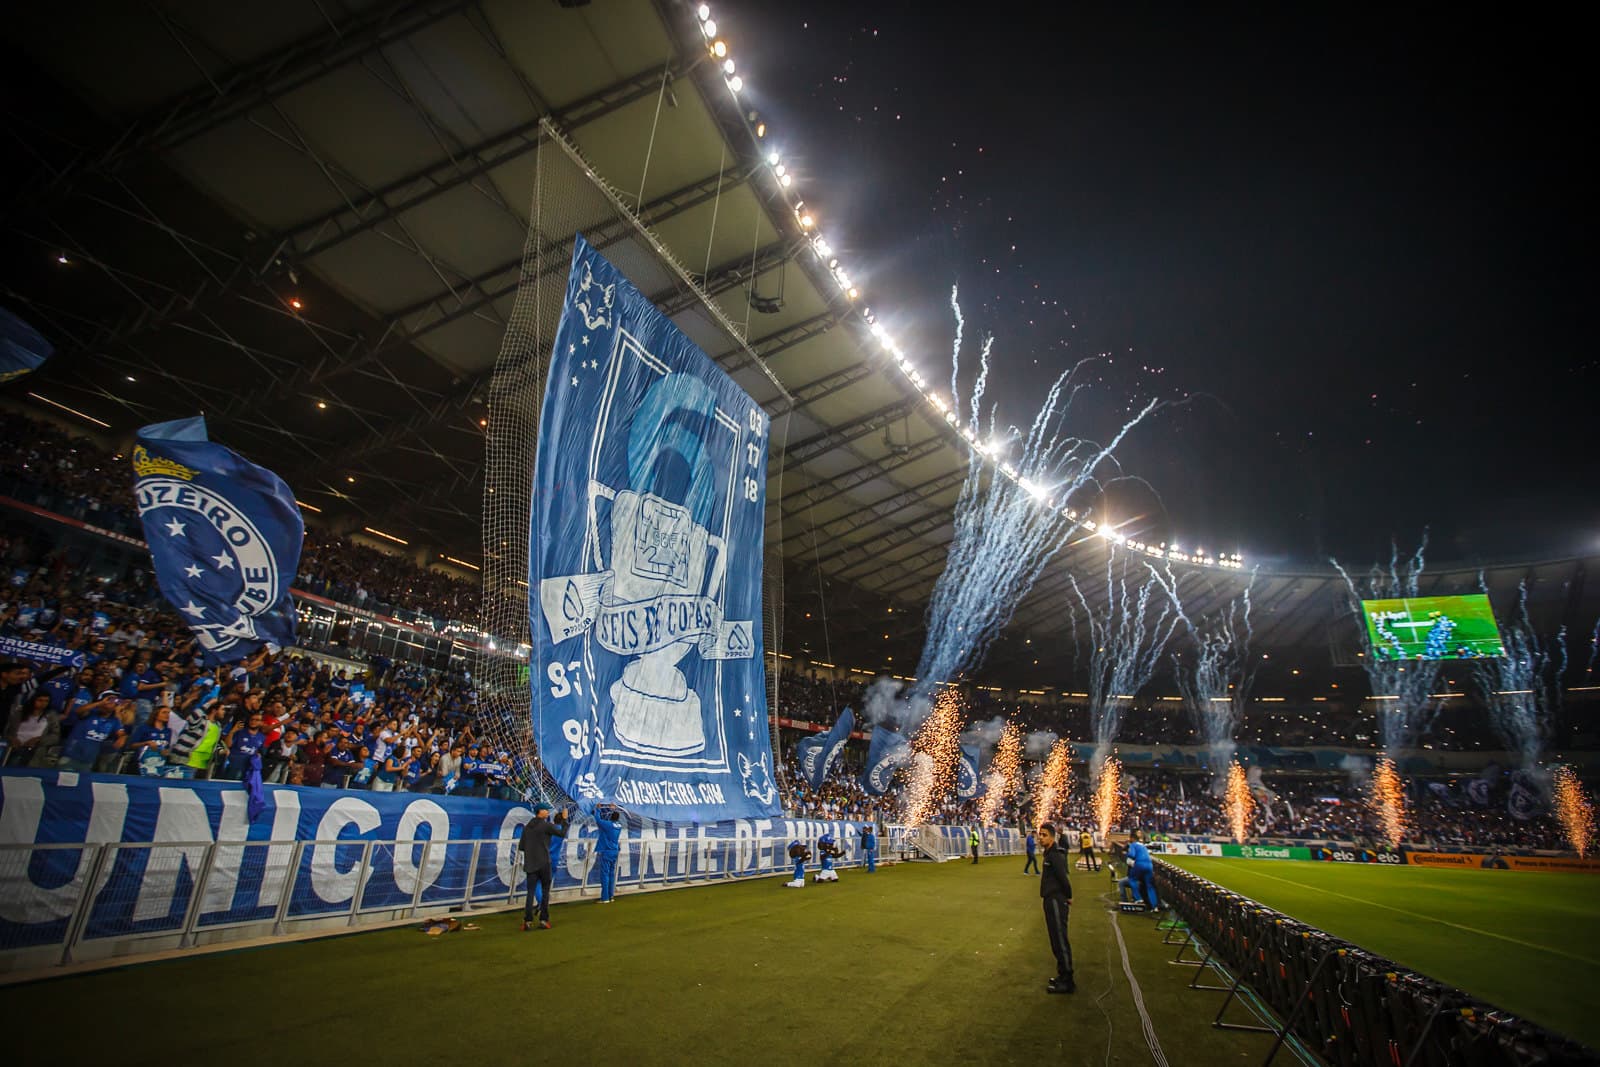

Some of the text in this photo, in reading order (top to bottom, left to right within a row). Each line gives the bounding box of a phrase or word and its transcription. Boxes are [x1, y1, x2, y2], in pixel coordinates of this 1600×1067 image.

[749, 407, 762, 437] 03
[747, 442, 760, 469] 17
[744, 476, 758, 502] 18
[601, 609, 639, 649] SEIS
[668, 601, 712, 635] COPAS
[736, 820, 773, 871] DE
[1254, 848, 1290, 858] Sicredi
[1413, 854, 1465, 865] Continental
